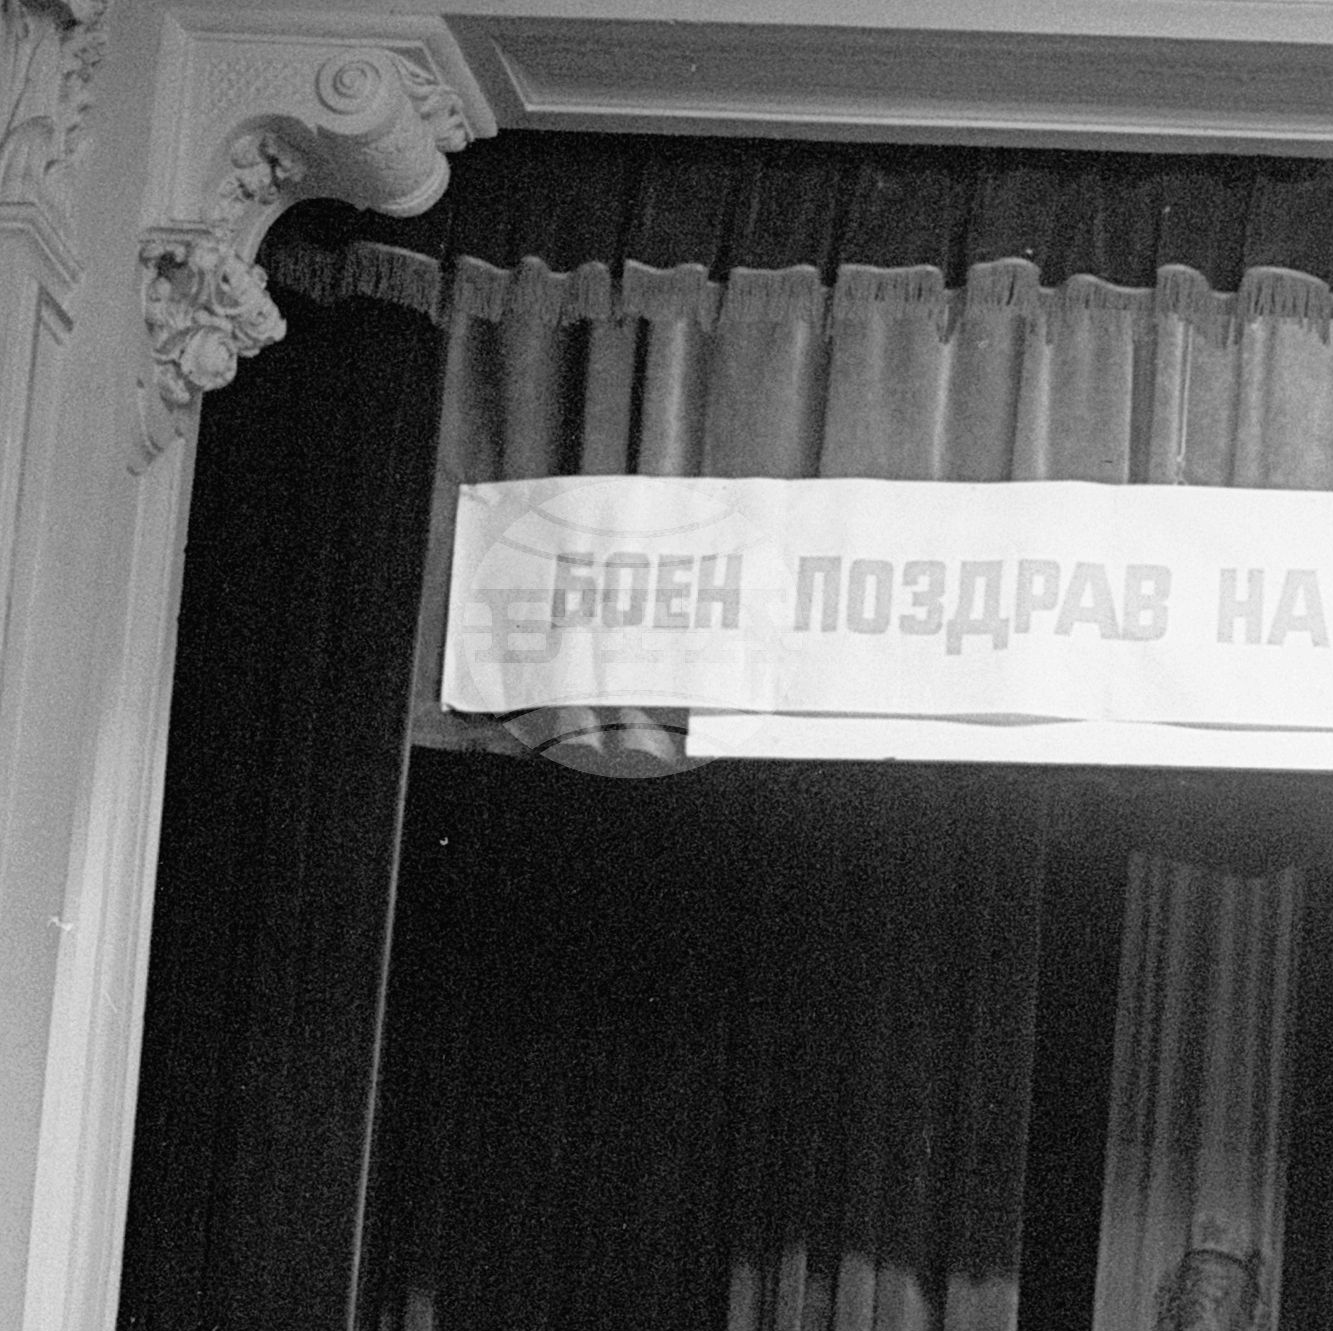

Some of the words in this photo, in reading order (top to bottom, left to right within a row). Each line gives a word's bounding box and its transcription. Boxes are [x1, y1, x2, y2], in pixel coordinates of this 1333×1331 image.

[551, 552, 743, 631] БОЕН
[793, 556, 1172, 655] ПОЗДРАВ
[1217, 568, 1329, 647] НА
